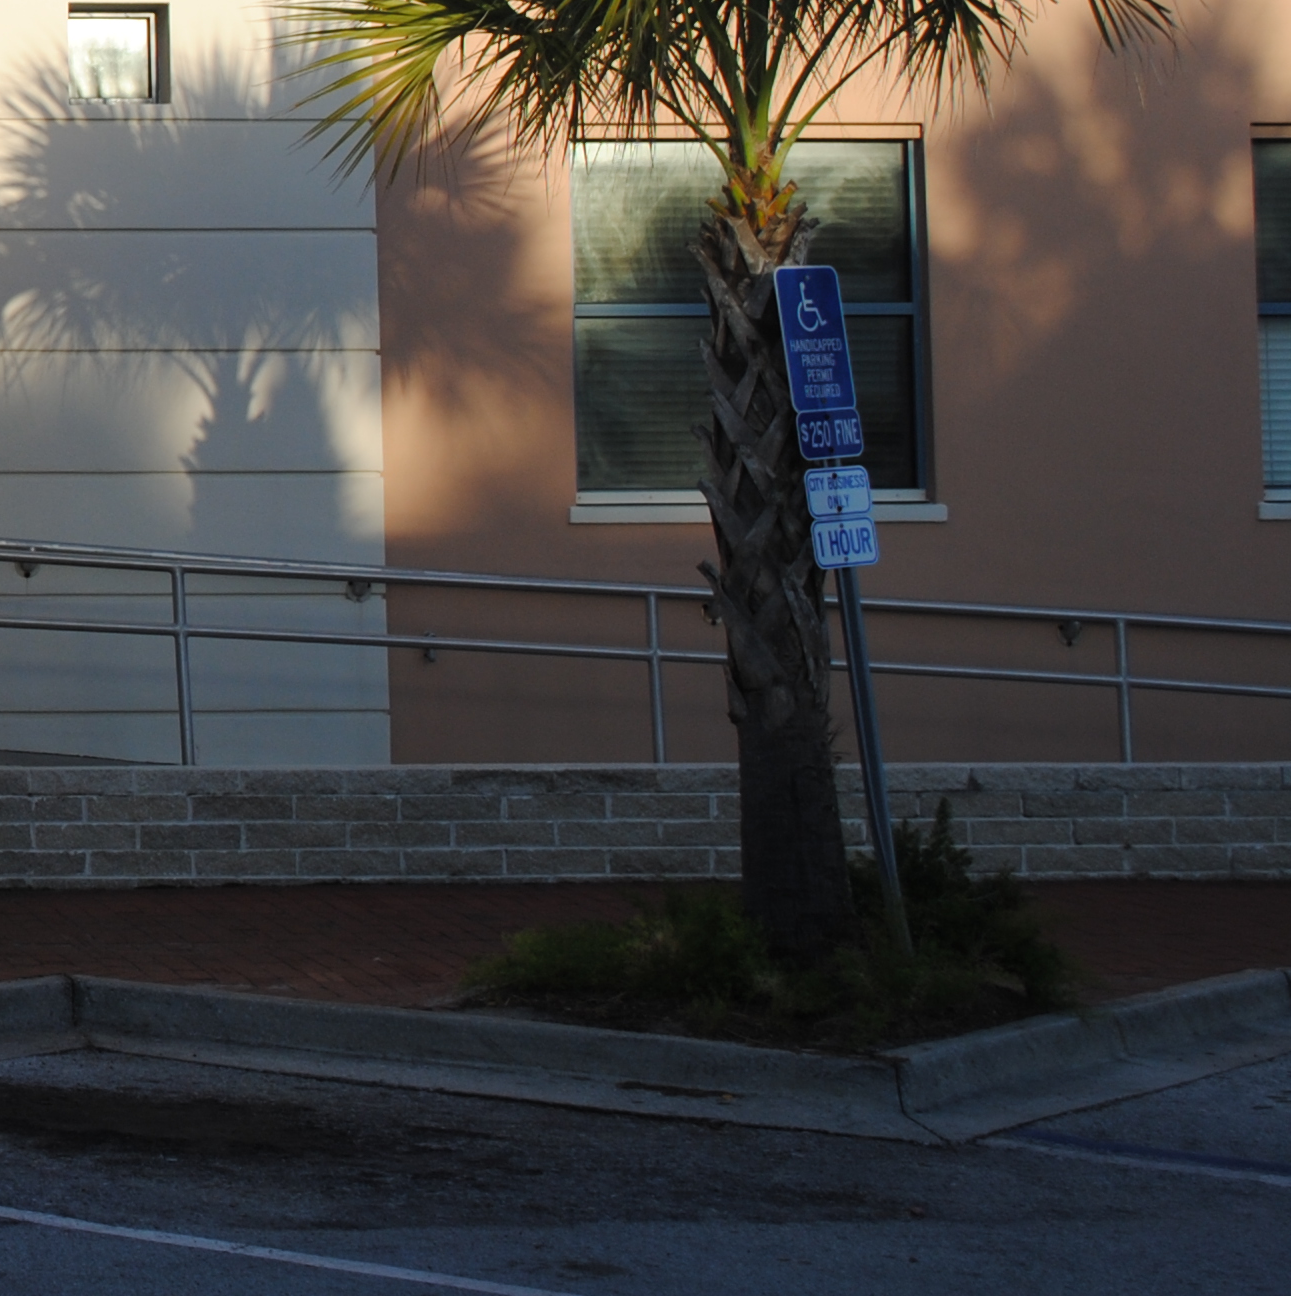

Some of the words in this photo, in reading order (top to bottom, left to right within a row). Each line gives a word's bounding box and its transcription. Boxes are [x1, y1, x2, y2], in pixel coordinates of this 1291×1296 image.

[789, 338, 843, 352] HANDICAPPED
[801, 353, 836, 367] PARKING
[806, 368, 833, 383] PERMIT
[804, 384, 841, 398] REQUIRED
[801, 420, 831, 448] $250
[834, 418, 860, 445] FINE
[809, 477, 825, 491] CITY
[827, 474, 865, 490] BUSINESS
[827, 495, 849, 509] ONLY
[818, 531, 825, 557] 1
[828, 527, 872, 557] HOUR
